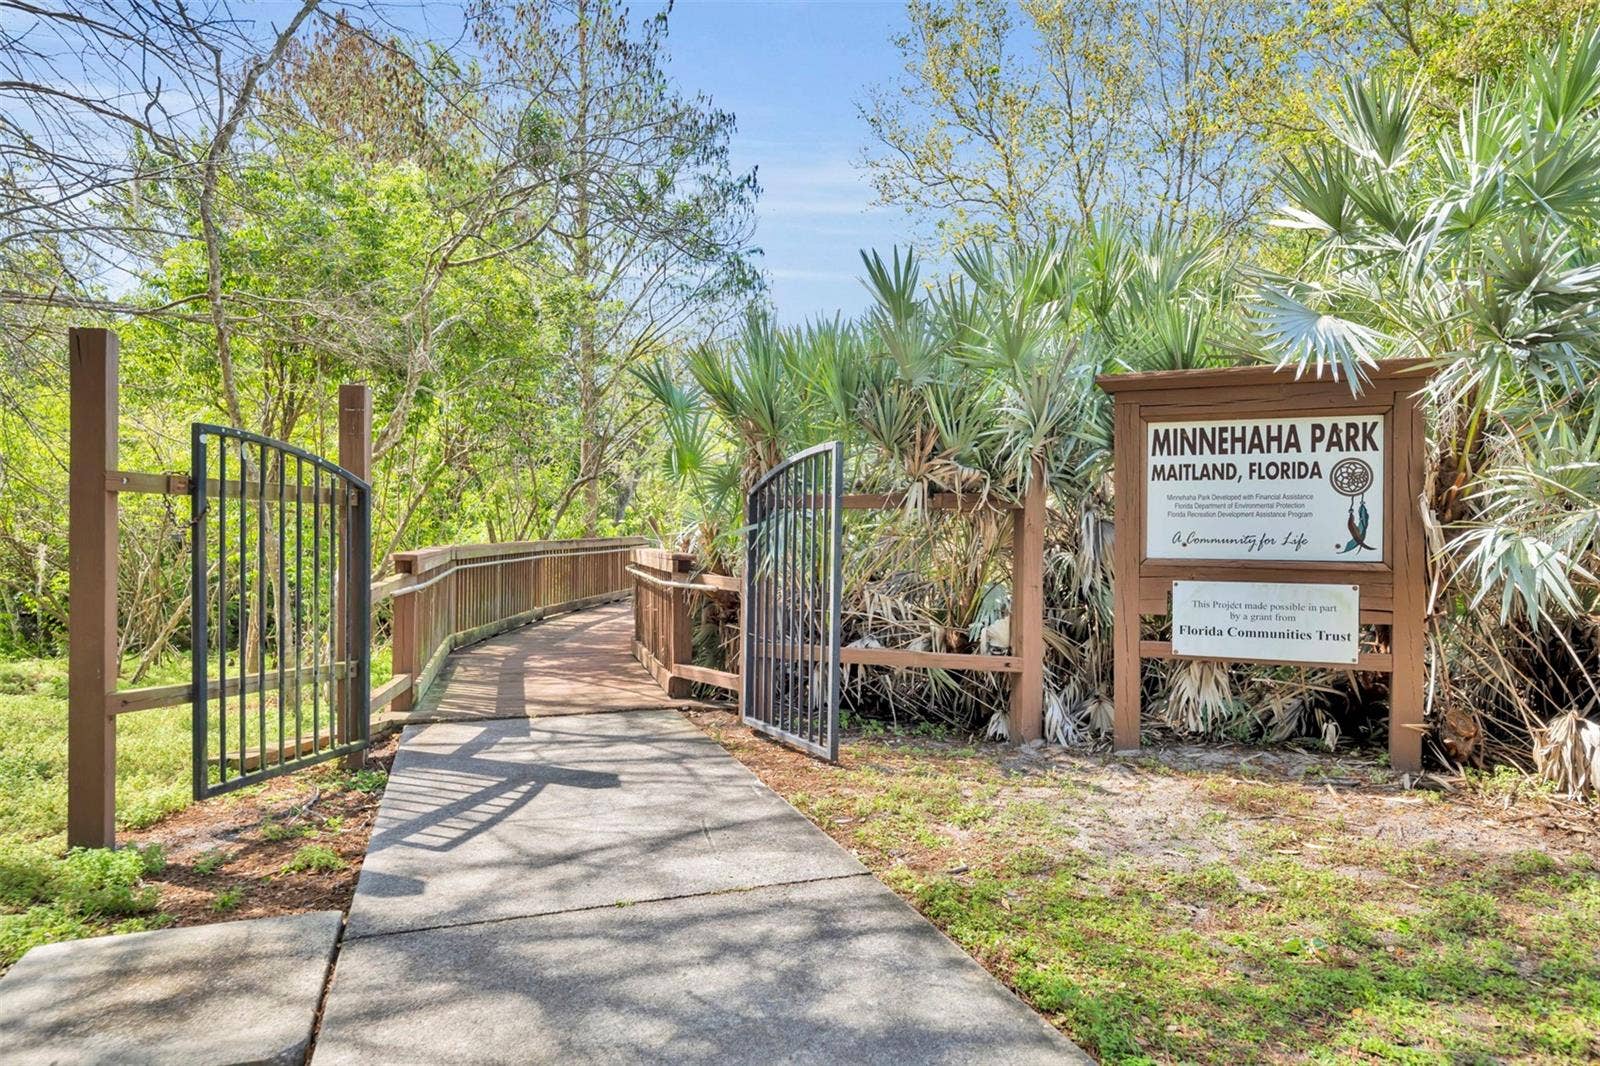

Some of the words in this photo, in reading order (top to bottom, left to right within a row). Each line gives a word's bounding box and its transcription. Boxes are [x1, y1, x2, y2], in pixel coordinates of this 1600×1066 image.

[1151, 424, 1301, 456] MINNEHAHA
[1310, 421, 1379, 453] PARK
[1151, 463, 1242, 483] MAITLAND,
[1249, 461, 1322, 480] FLORIDA
[1211, 494, 1241, 502] Developed
[1194, 502, 1226, 510] Department
[1217, 511, 1254, 519] Development
[1287, 511, 1313, 519] Program
[1171, 531, 1182, 544] A
[1186, 531, 1256, 552] Community
[1257, 533, 1277, 551] for
[1281, 532, 1309, 552] Life
[1192, 600, 1210, 609] This
[1212, 601, 1242, 611] Project
[1244, 602, 1267, 610] made
[1270, 602, 1305, 612] possible
[1308, 603, 1317, 612] in
[1319, 605, 1337, 614] part
[1230, 612, 1239, 622] by
[1250, 614, 1273, 623] grant
[1275, 613, 1296, 622] from
[1179, 625, 1223, 637] Florida
[1227, 627, 1312, 640] Communities
[1316, 630, 1352, 642] Trust
